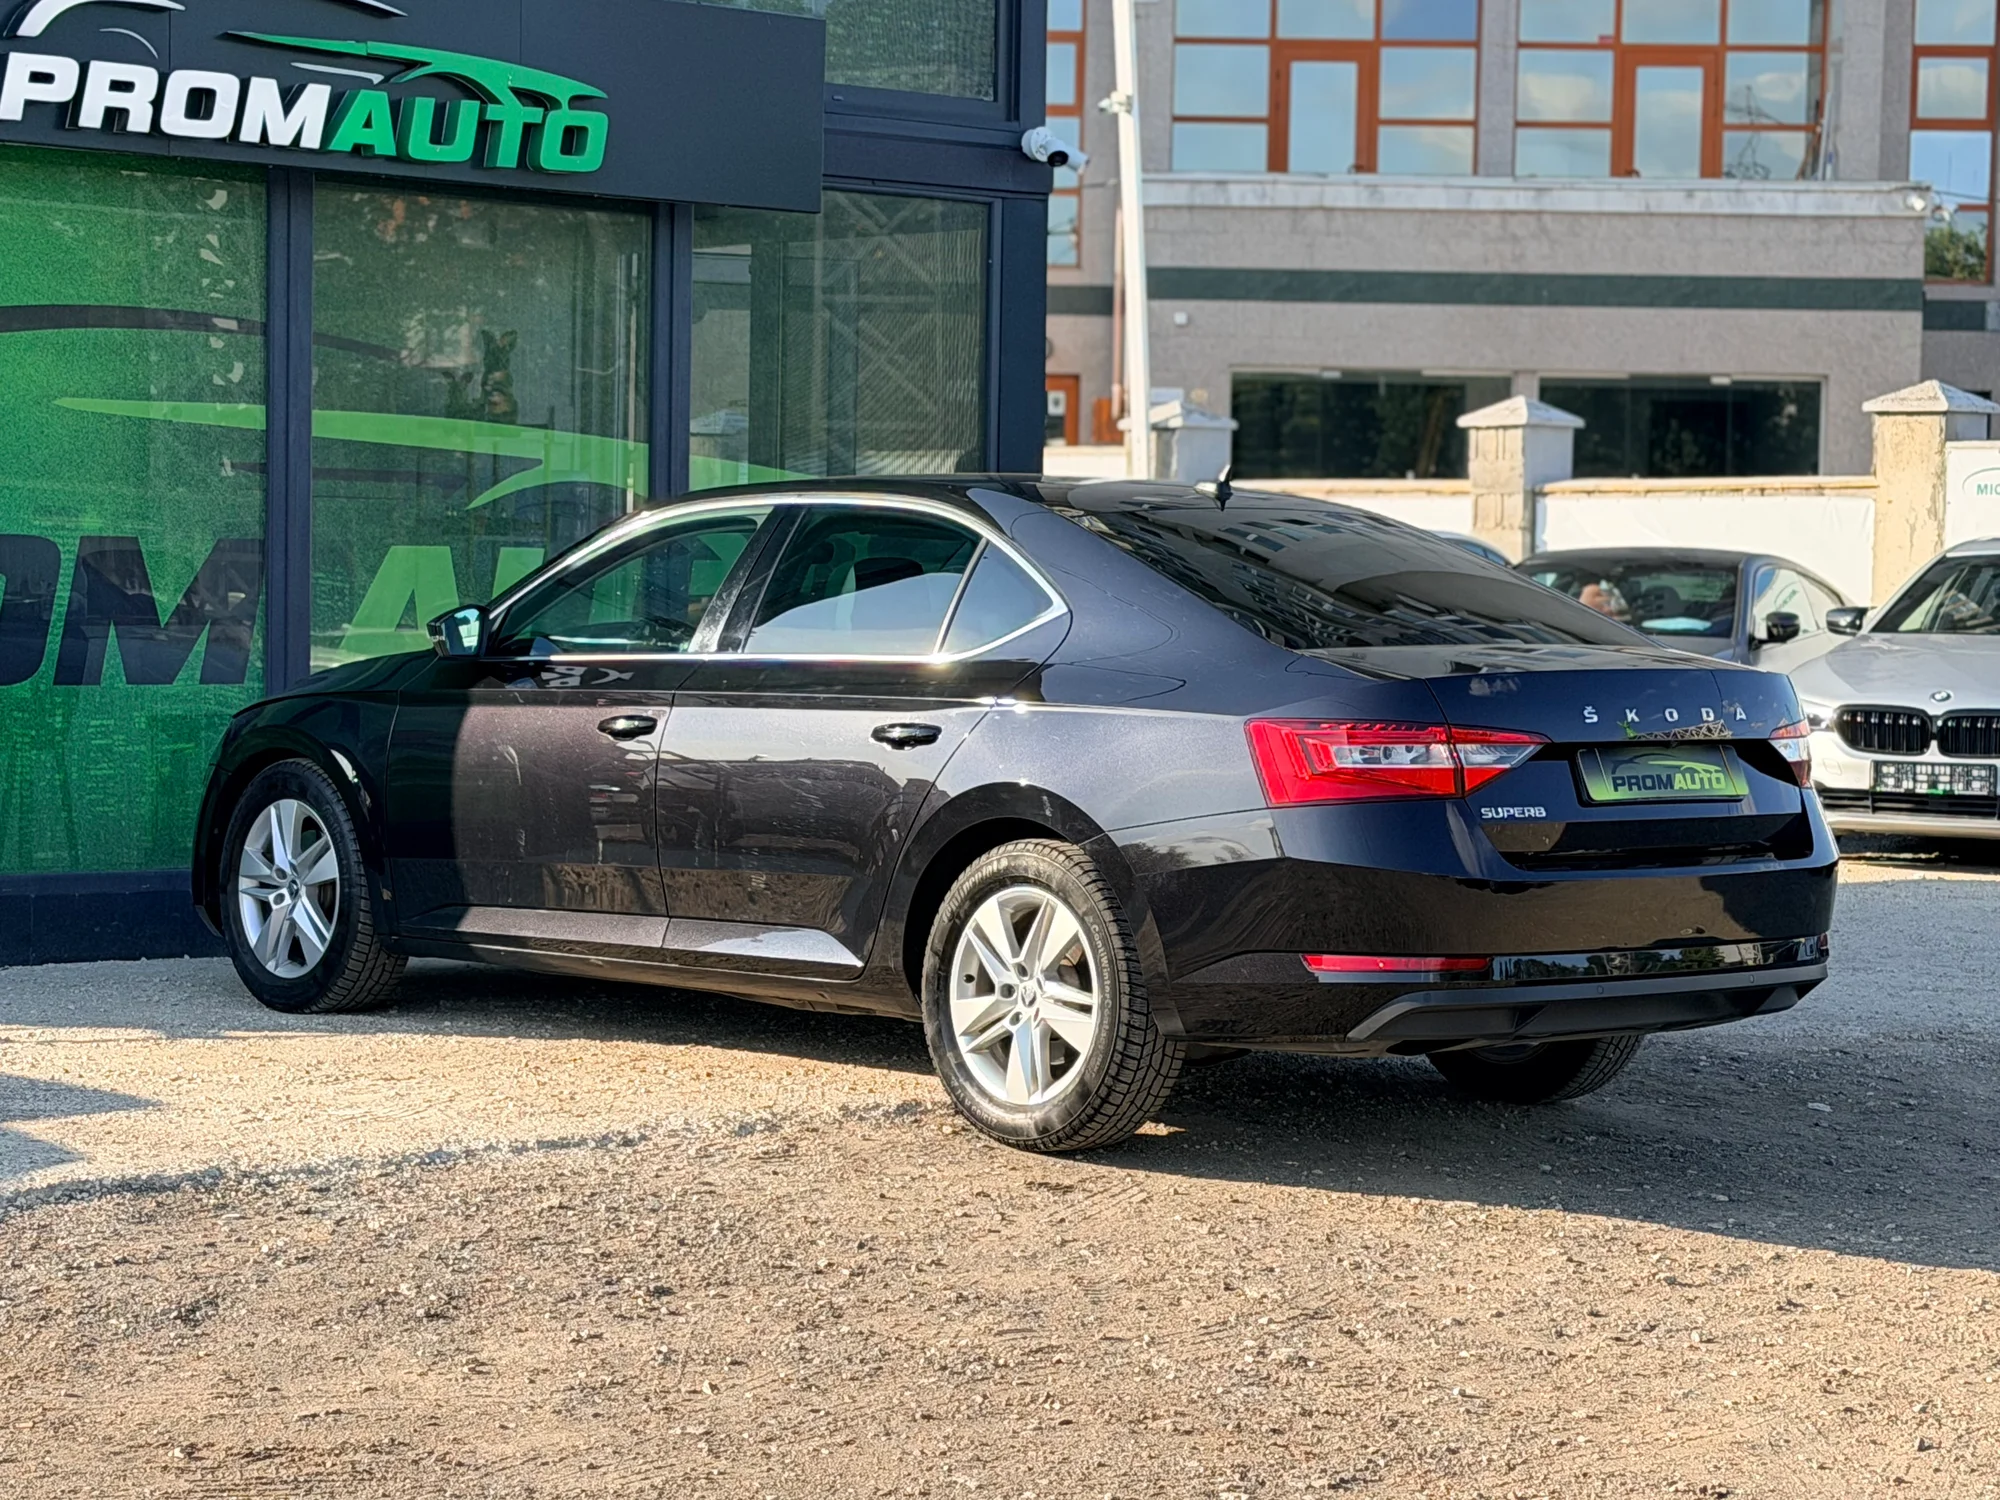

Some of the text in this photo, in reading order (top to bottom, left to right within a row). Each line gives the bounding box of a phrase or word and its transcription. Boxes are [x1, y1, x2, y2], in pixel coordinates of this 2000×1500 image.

[0, 51, 609, 174] PROMAUTO
[1583, 705, 1747, 724] ŠKODA
[1611, 771, 1727, 793] PROMAUTO
[1480, 806, 1547, 819] SUPERB
